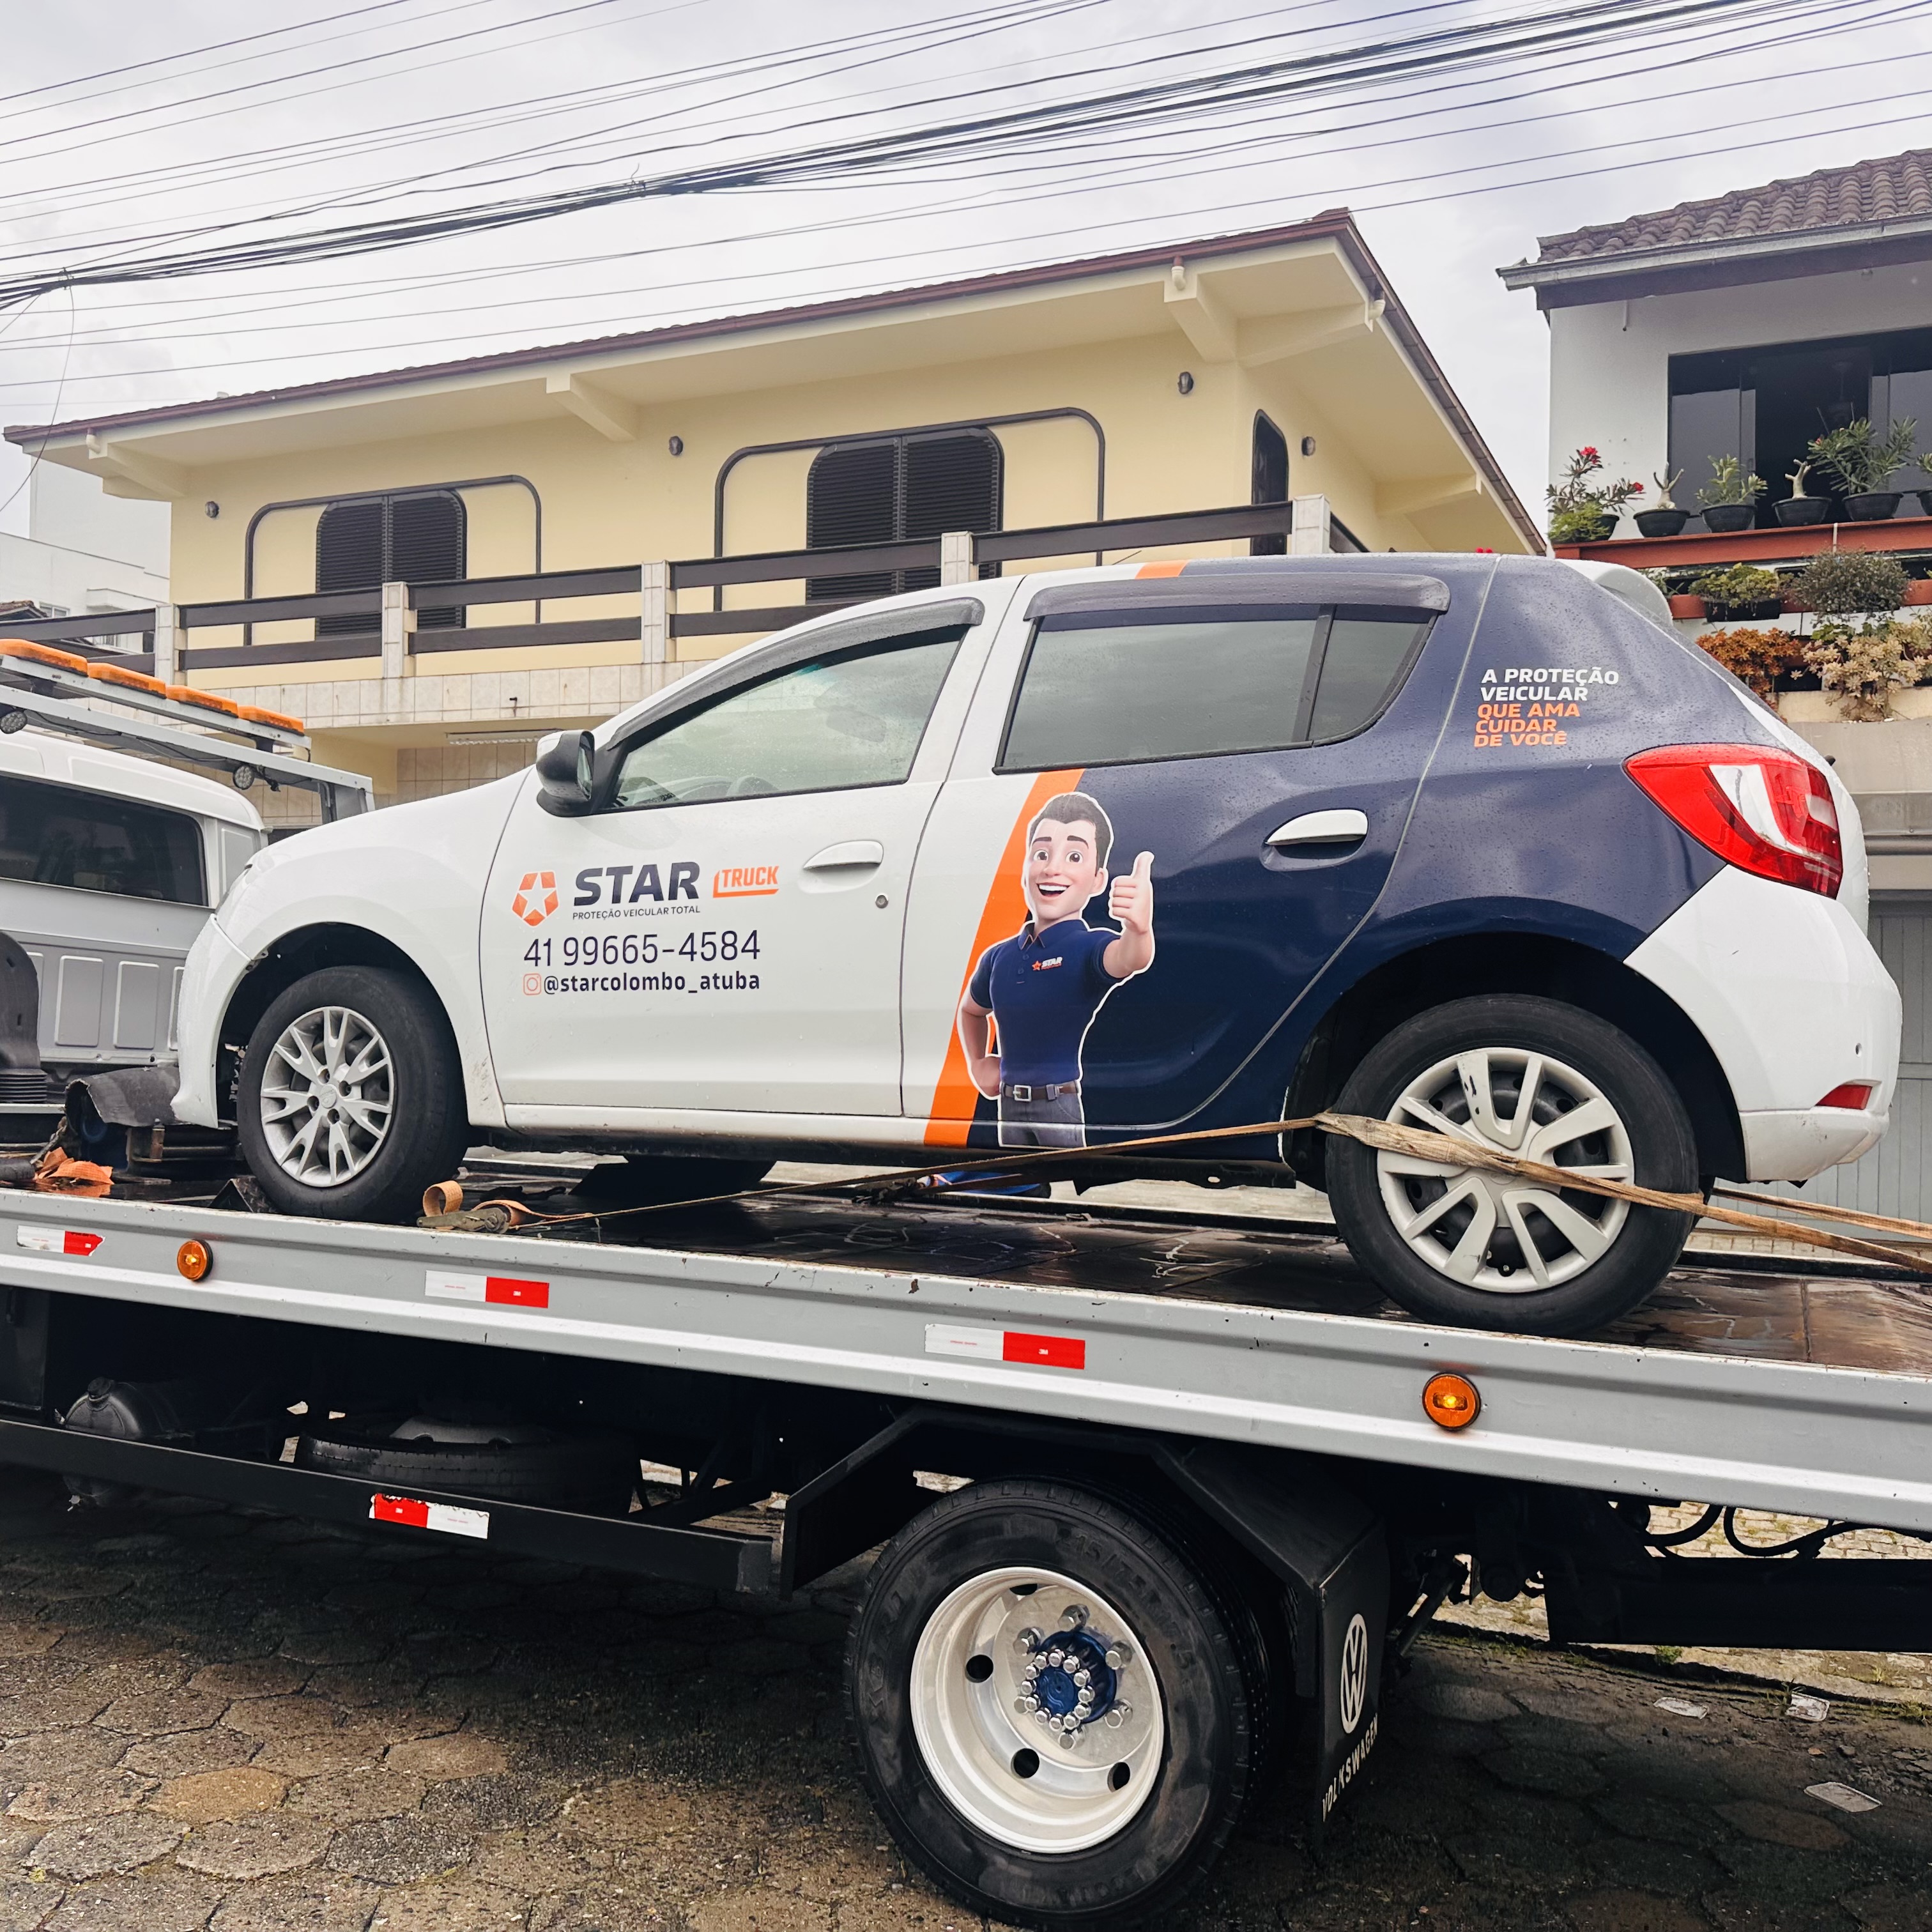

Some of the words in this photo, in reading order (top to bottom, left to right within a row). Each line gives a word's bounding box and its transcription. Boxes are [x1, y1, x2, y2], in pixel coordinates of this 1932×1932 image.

[1481, 669, 1498, 684] A
[1504, 666, 1619, 686] PROTEÇÃO
[1480, 686, 1588, 701] VEICULAR
[1477, 703, 1521, 720] QUE
[1528, 703, 1580, 717] AMA
[1476, 719, 1557, 733] CUIDAR
[1474, 734, 1503, 747] DE
[1510, 730, 1567, 746] VOCÊ
[574, 861, 700, 907] STAR
[723, 866, 779, 888] TRUCK
[572, 908, 621, 921] PROTEÇÃO
[624, 907, 669, 917] VEICULAR
[671, 905, 700, 915] TOTAL
[524, 938, 551, 967] 41
[564, 930, 760, 966] 99665-4584
[544, 971, 760, 995] @starcolombo_atuba
[1322, 1712, 1377, 1822] VOLKSWAGEN
